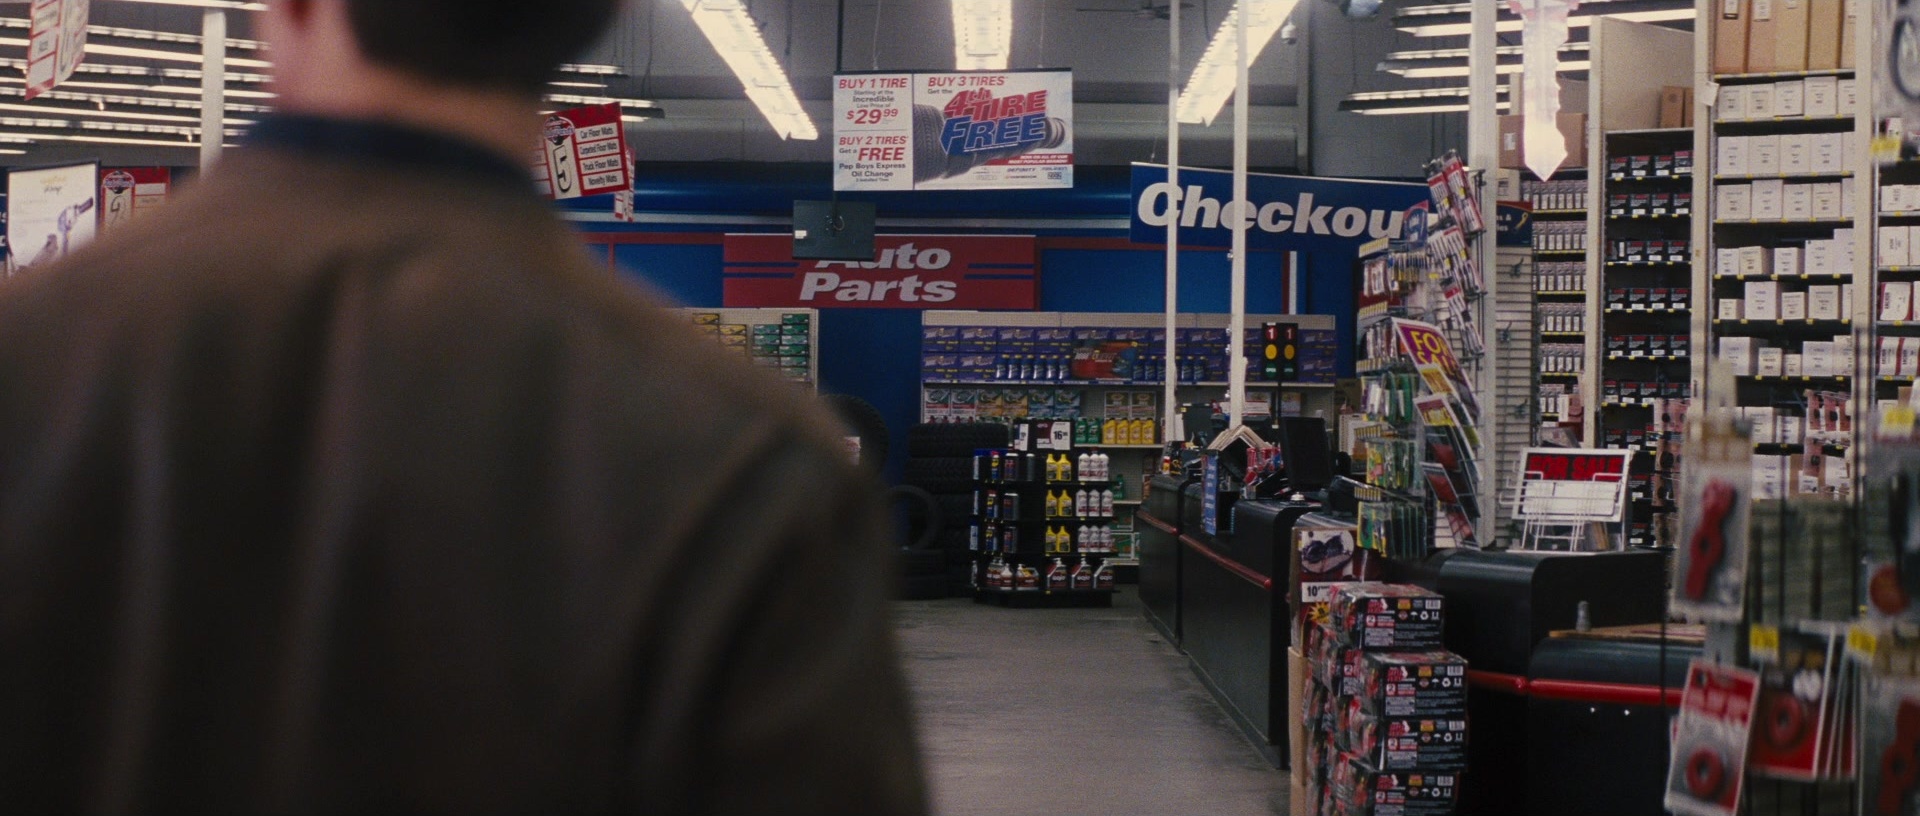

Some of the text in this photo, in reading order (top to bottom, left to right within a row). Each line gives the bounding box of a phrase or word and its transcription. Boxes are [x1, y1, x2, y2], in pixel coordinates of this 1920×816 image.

[839, 77, 908, 89] BUY 1 TIRE
[928, 76, 956, 87] BUY
[958, 76, 966, 86] 3
[944, 87, 992, 118] 4th
[967, 90, 1048, 121] TIRE
[839, 136, 863, 146] BUY
[865, 136, 873, 145] 2
[940, 113, 1046, 155] FREE
[858, 147, 905, 161] FREE
[799, 271, 958, 303] Parts
[1268, 328, 1275, 339] 1
[1287, 328, 1293, 339] 1
[1529, 455, 1622, 482] FOR SALE
